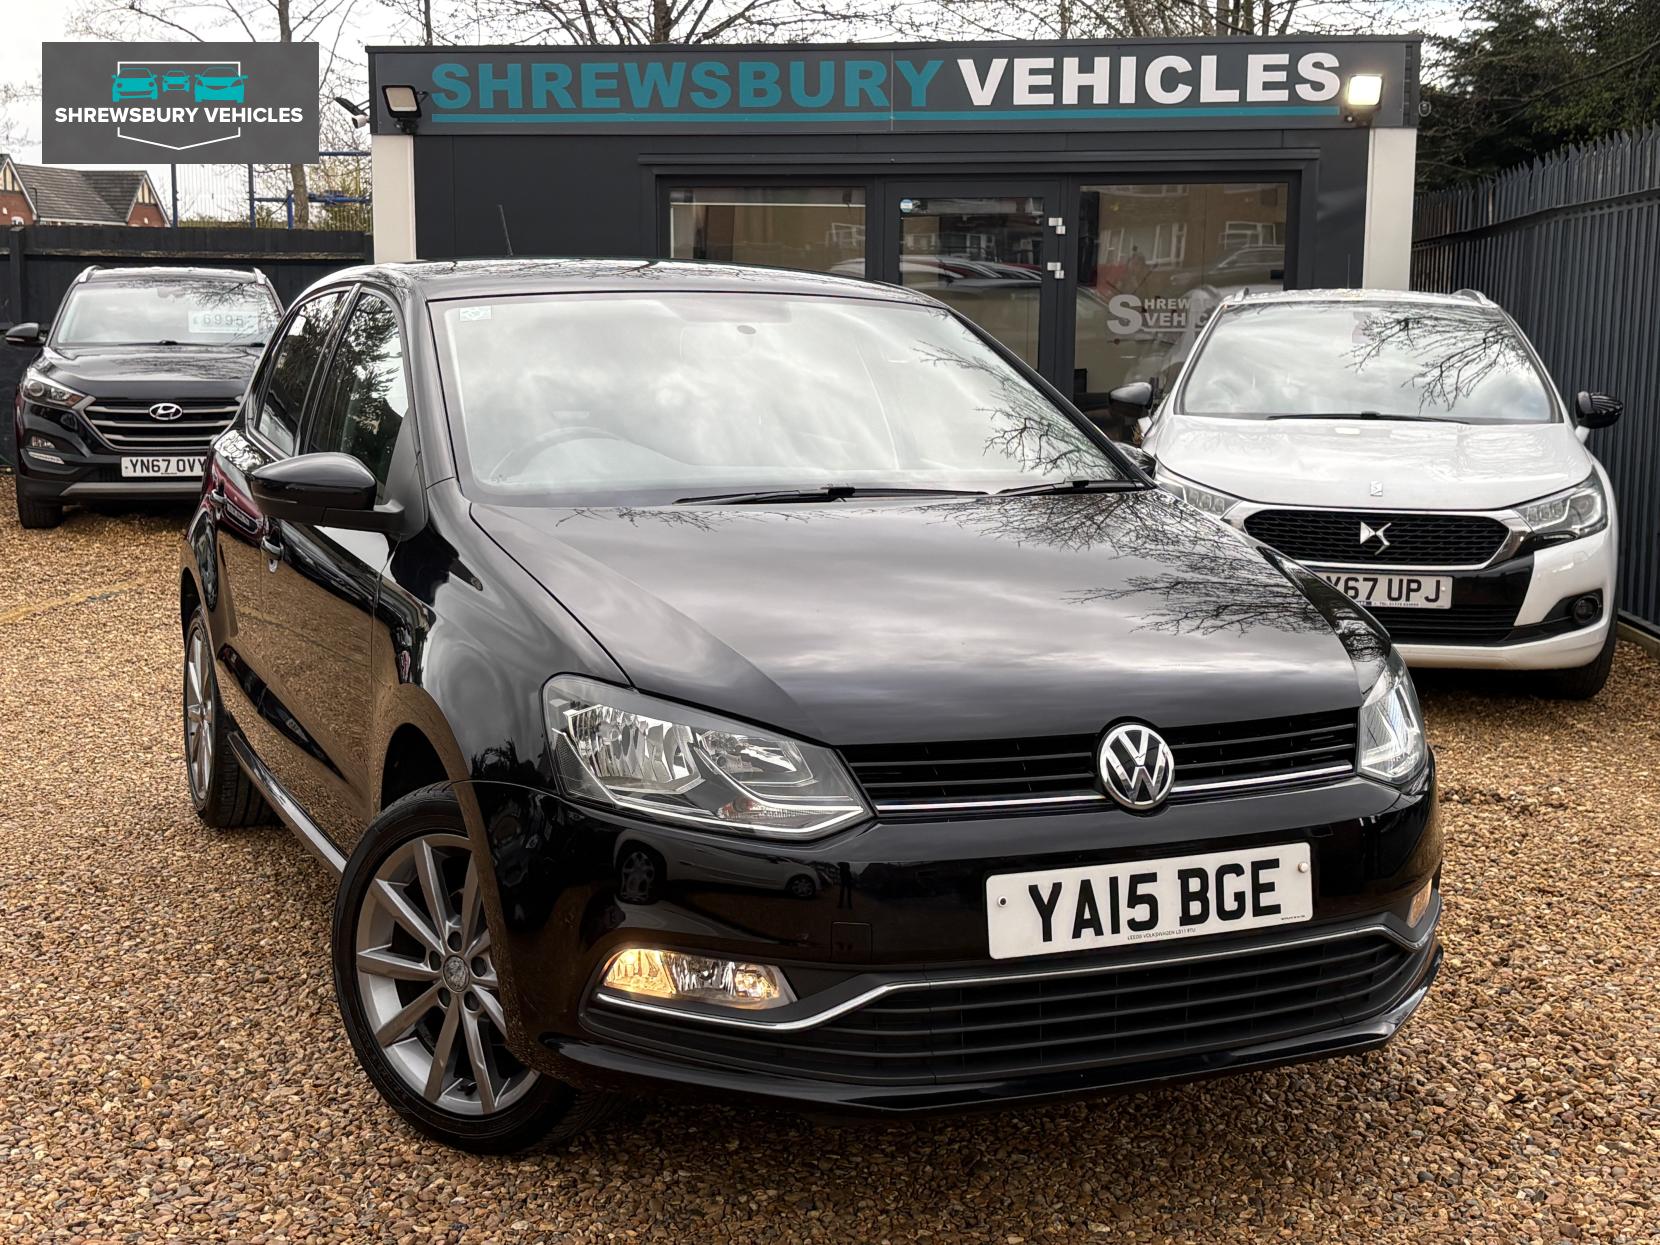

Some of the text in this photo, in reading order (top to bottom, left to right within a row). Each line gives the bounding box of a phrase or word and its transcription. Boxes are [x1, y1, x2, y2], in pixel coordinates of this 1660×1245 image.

[432, 52, 1341, 109] SHREWSBURY VEHICLES
[129, 459, 171, 473] YN67
[1387, 578, 1440, 603] UPJ
[1028, 858, 1282, 942] YA15 BGE
